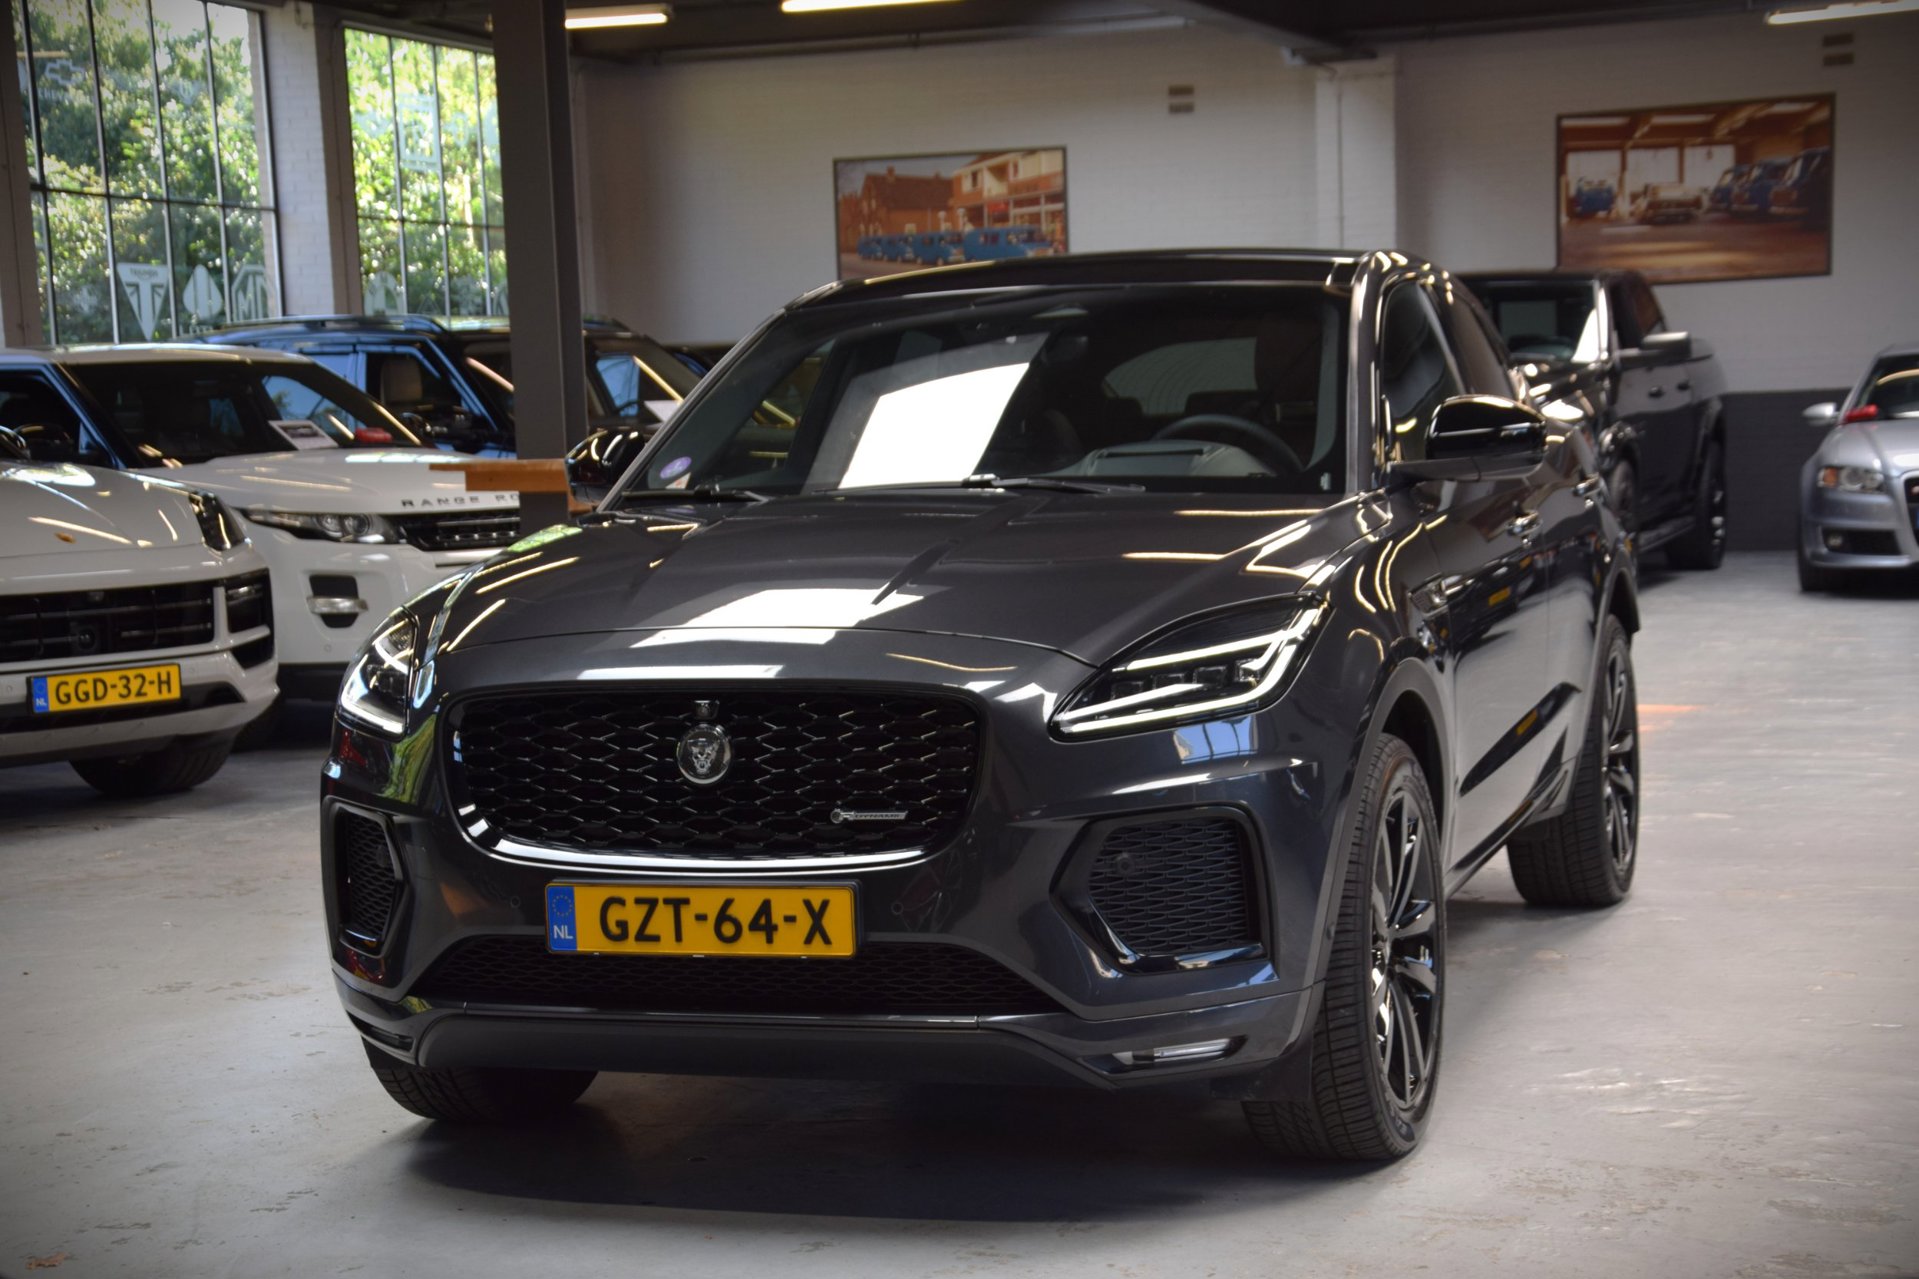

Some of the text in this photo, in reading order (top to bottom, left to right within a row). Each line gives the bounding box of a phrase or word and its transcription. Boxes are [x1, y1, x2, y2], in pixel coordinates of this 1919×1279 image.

[401, 496, 480, 507] RANGE
[35, 671, 172, 706] NL GGD-32-H
[553, 896, 833, 946] NL GZT-64-X
